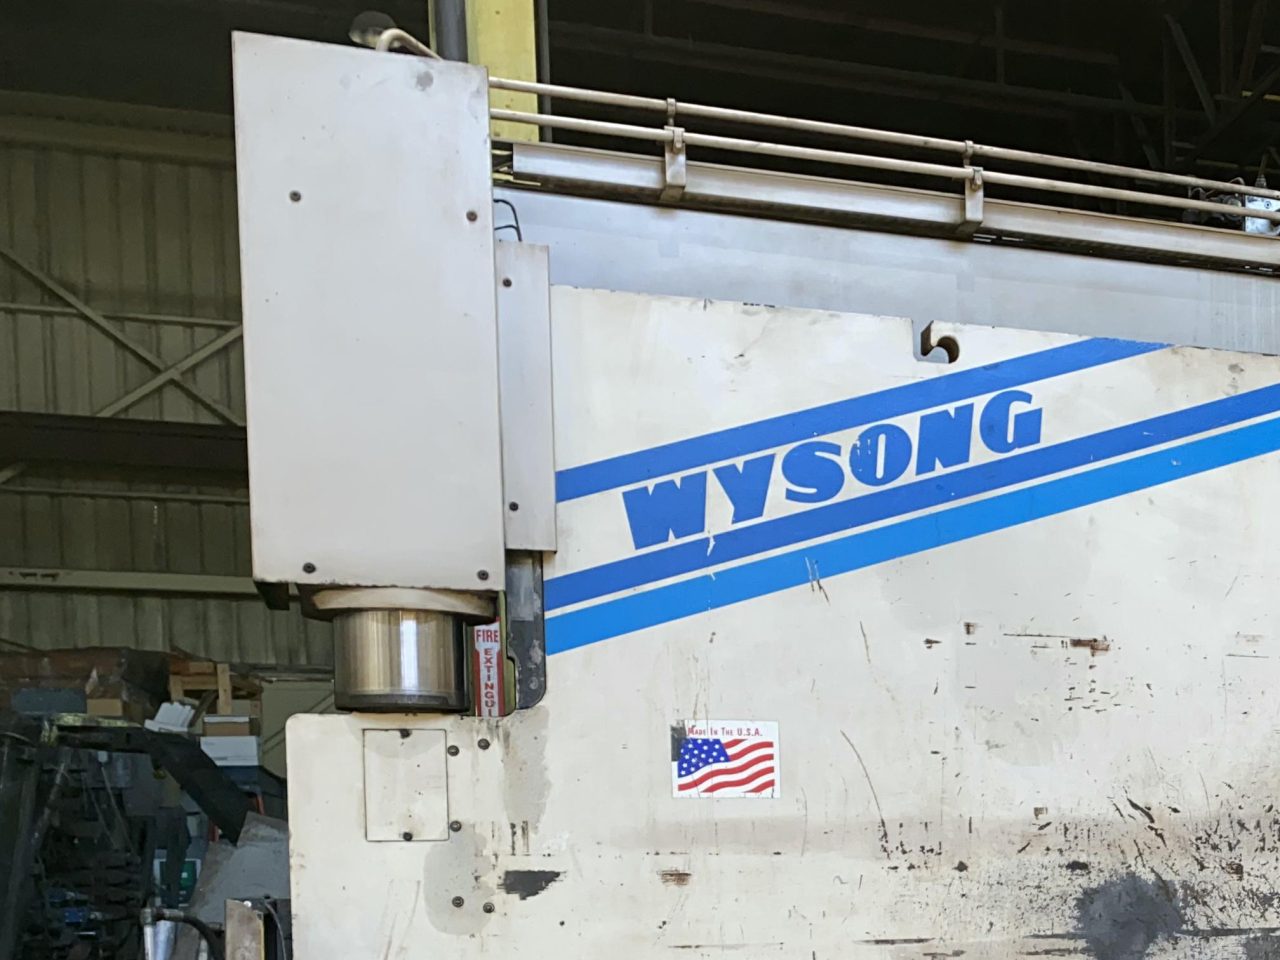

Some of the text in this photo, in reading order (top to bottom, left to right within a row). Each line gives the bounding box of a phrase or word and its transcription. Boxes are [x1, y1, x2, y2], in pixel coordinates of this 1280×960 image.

[622, 389, 1042, 550] WYSONG
[475, 629, 499, 643] FIRE
[737, 728, 763, 737] U.S.A.
